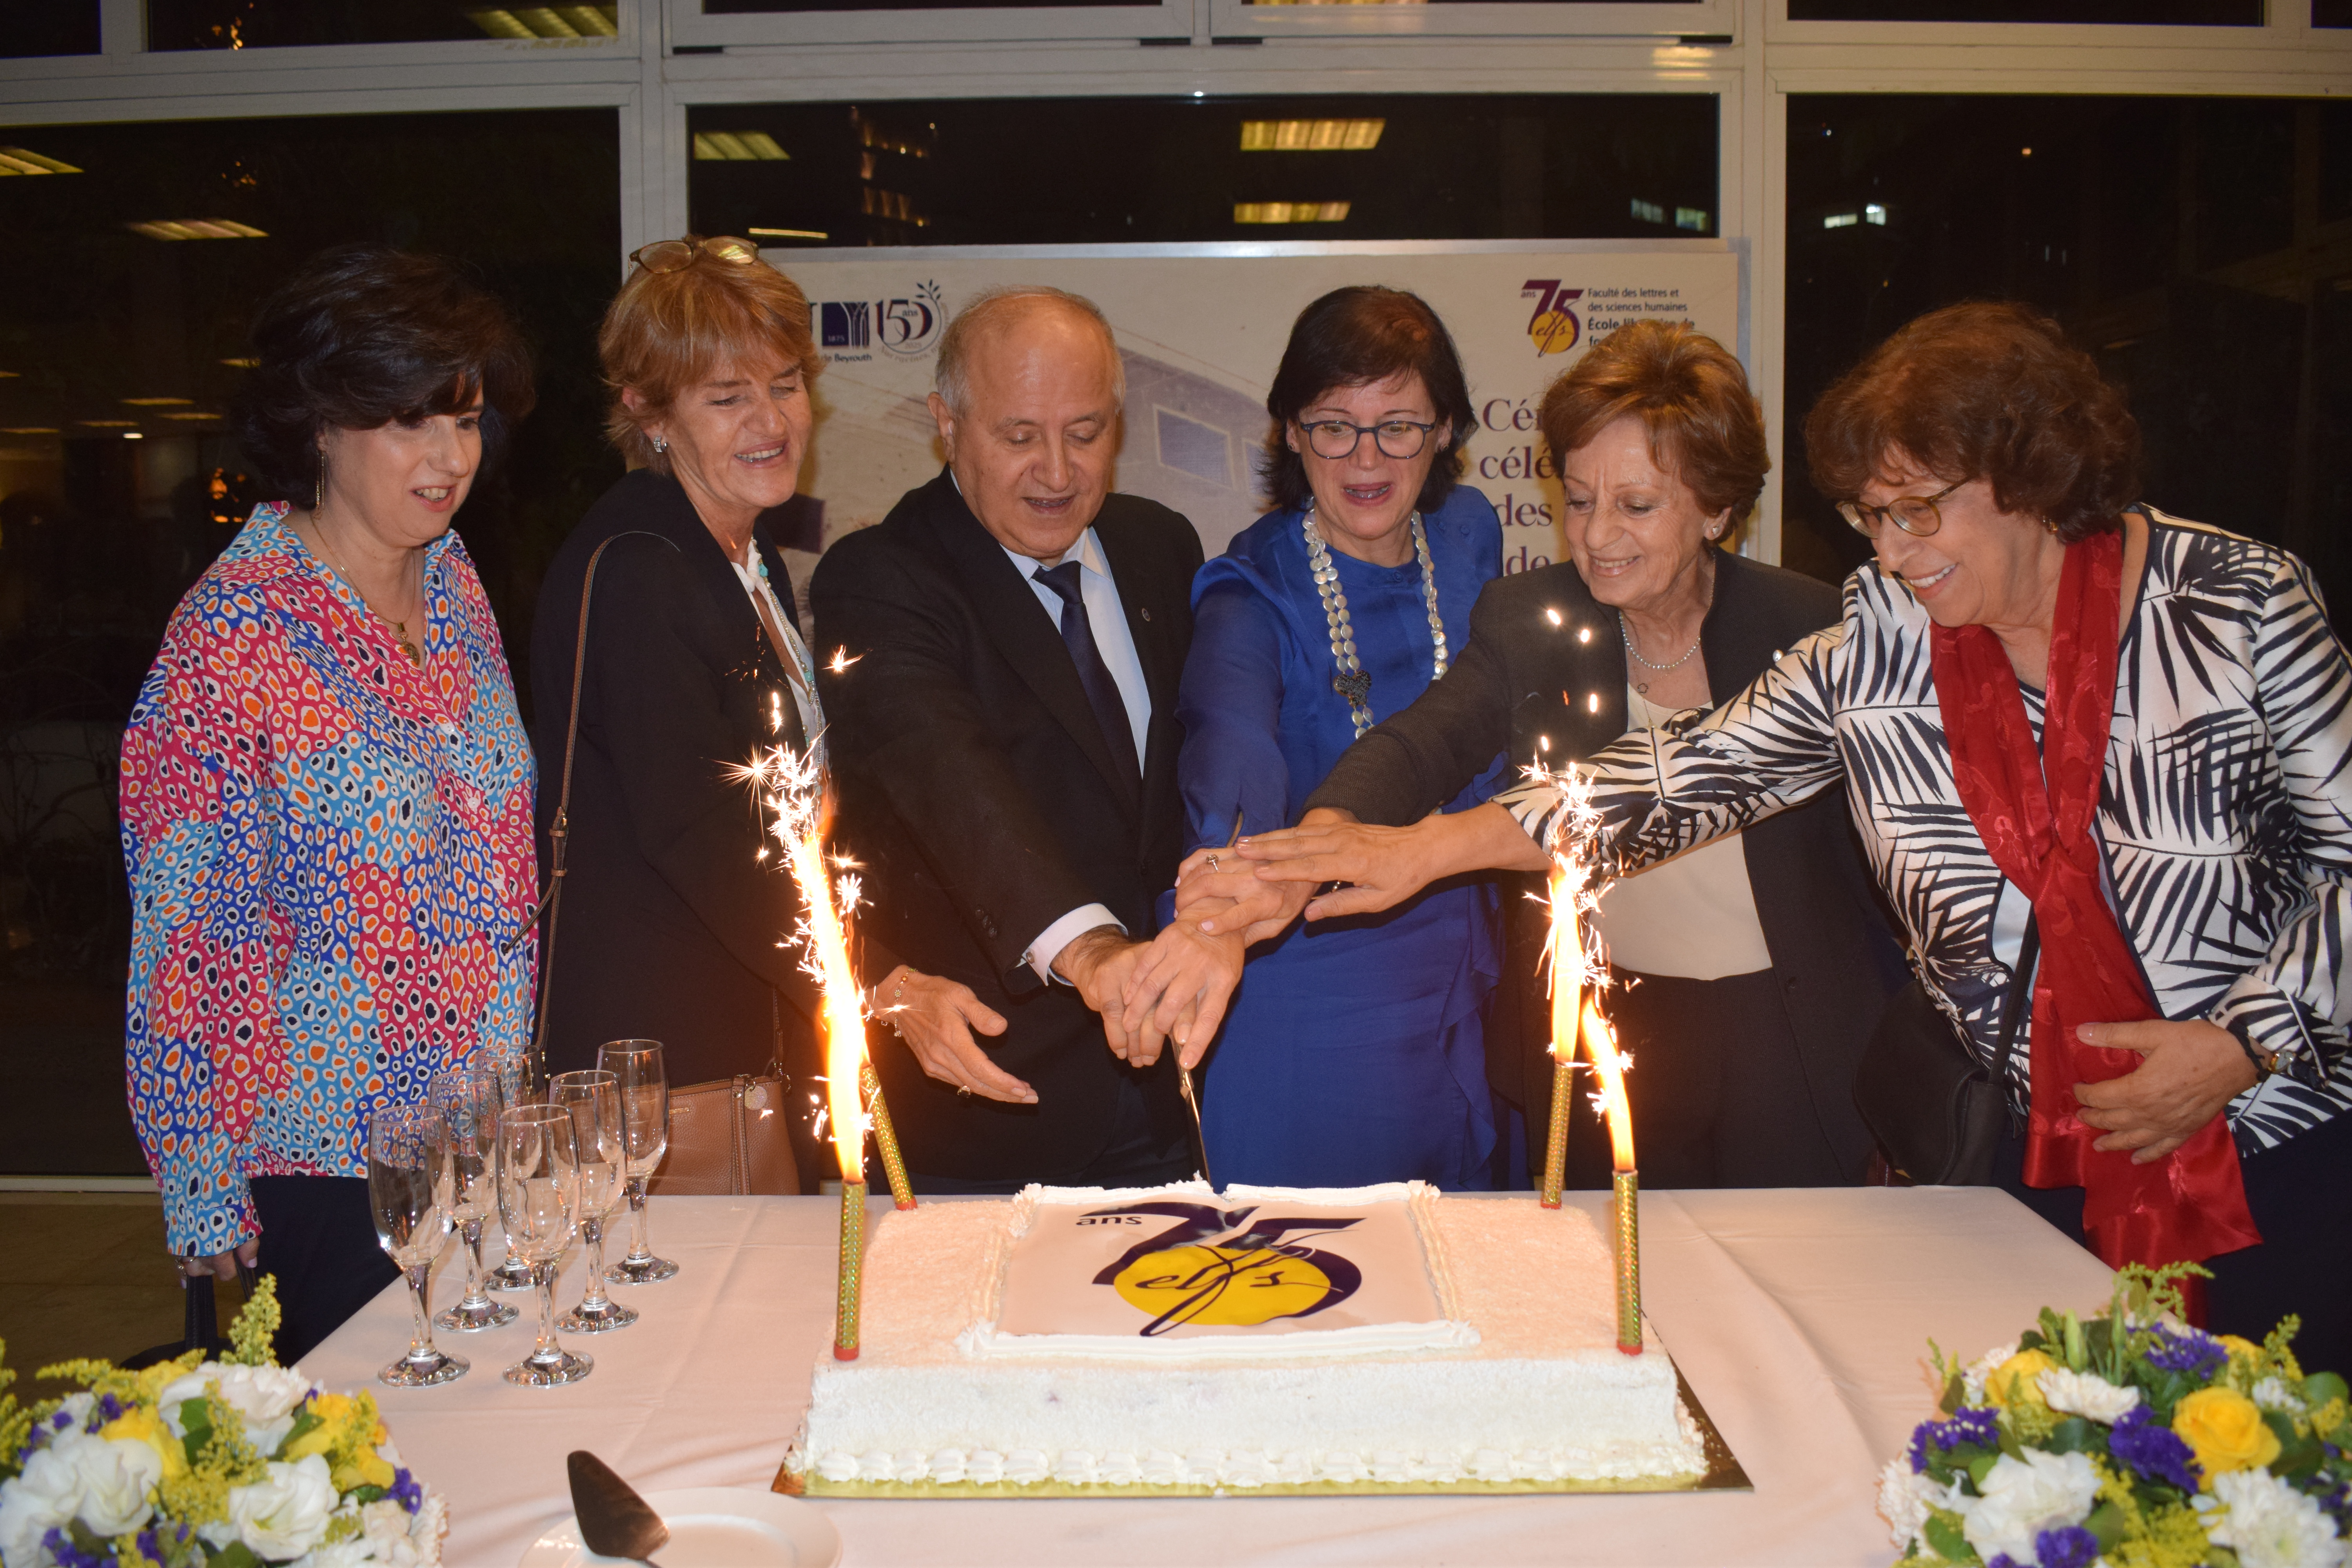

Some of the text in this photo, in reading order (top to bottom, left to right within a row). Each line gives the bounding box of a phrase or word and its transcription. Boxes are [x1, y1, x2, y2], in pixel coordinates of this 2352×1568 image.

[1588, 287, 1619, 297] Faculté
[1622, 288, 1637, 297] des
[1640, 288, 1667, 297] lettres
[1588, 301, 1688, 311] des sciences humaines
[1588, 316, 1620, 330] École
[835, 353, 872, 363] Beyrouth
[1494, 493, 1552, 526] des
[1076, 1216, 1142, 1226] ans
